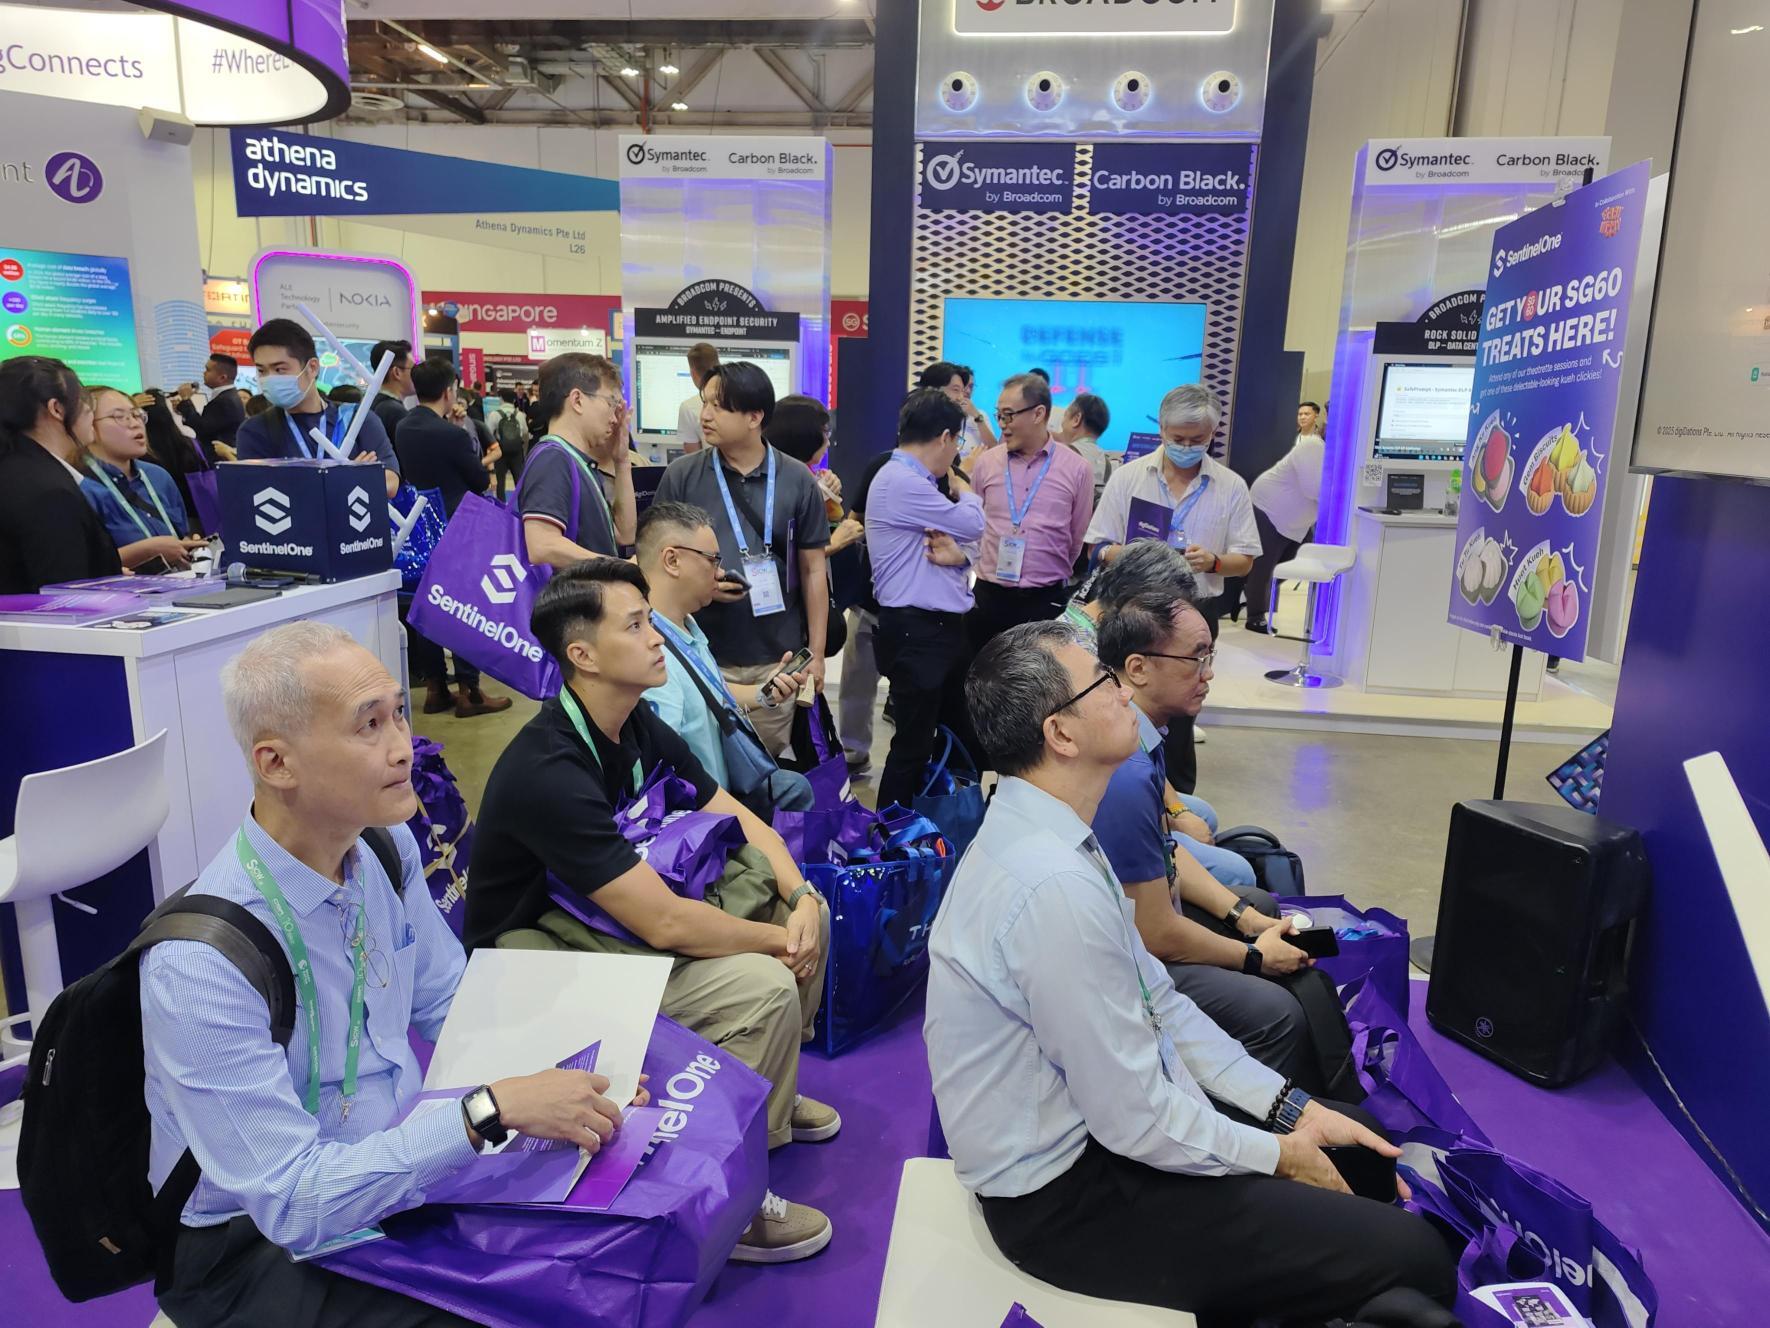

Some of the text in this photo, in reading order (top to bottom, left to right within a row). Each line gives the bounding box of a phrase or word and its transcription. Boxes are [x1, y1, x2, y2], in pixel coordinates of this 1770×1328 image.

[245, 136, 336, 170] athena
[647, 149, 818, 164] Symantec Carbon Black.
[1400, 152, 1600, 169] Symantec Carbon Black.
[961, 163, 1063, 188] Symantec
[1093, 170, 1245, 190] Carbon Black.
[1416, 170, 1470, 179] by Broadcom
[1540, 168, 1584, 177] by Broadco
[247, 162, 368, 201] dynamics
[985, 191, 1062, 203] by Broadcom
[1158, 194, 1237, 207] by Broadcom
[475, 218, 586, 241] Athena Dynamics Pte Ltd
[569, 243, 586, 254] L26
[1506, 232, 1562, 268] SentinelOne
[339, 291, 392, 307] NOKIA
[677, 281, 757, 309] BROADCOM PRESENTS
[1486, 299, 1515, 332] GET
[1564, 267, 1623, 309] SG60
[1428, 293, 1477, 320] BROADCOM
[655, 314, 778, 327] AMPLIFIED ENDPOINT SECURITY
[720, 327, 747, 336] ENDPOINT
[1424, 329, 1477, 340] ROCK SOLID
[1482, 308, 1618, 367] TREATS HERE!
[1447, 341, 1463, 350] DATA
[1554, 359, 1579, 371] sessions
[1579, 355, 1592, 366] and
[1533, 434, 1558, 461] Biscuits
[240, 540, 313, 557] SentinelOne
[340, 537, 383, 555] SentinelOne
[1526, 548, 1544, 565] Kueh
[427, 583, 544, 663] SentinelOne
